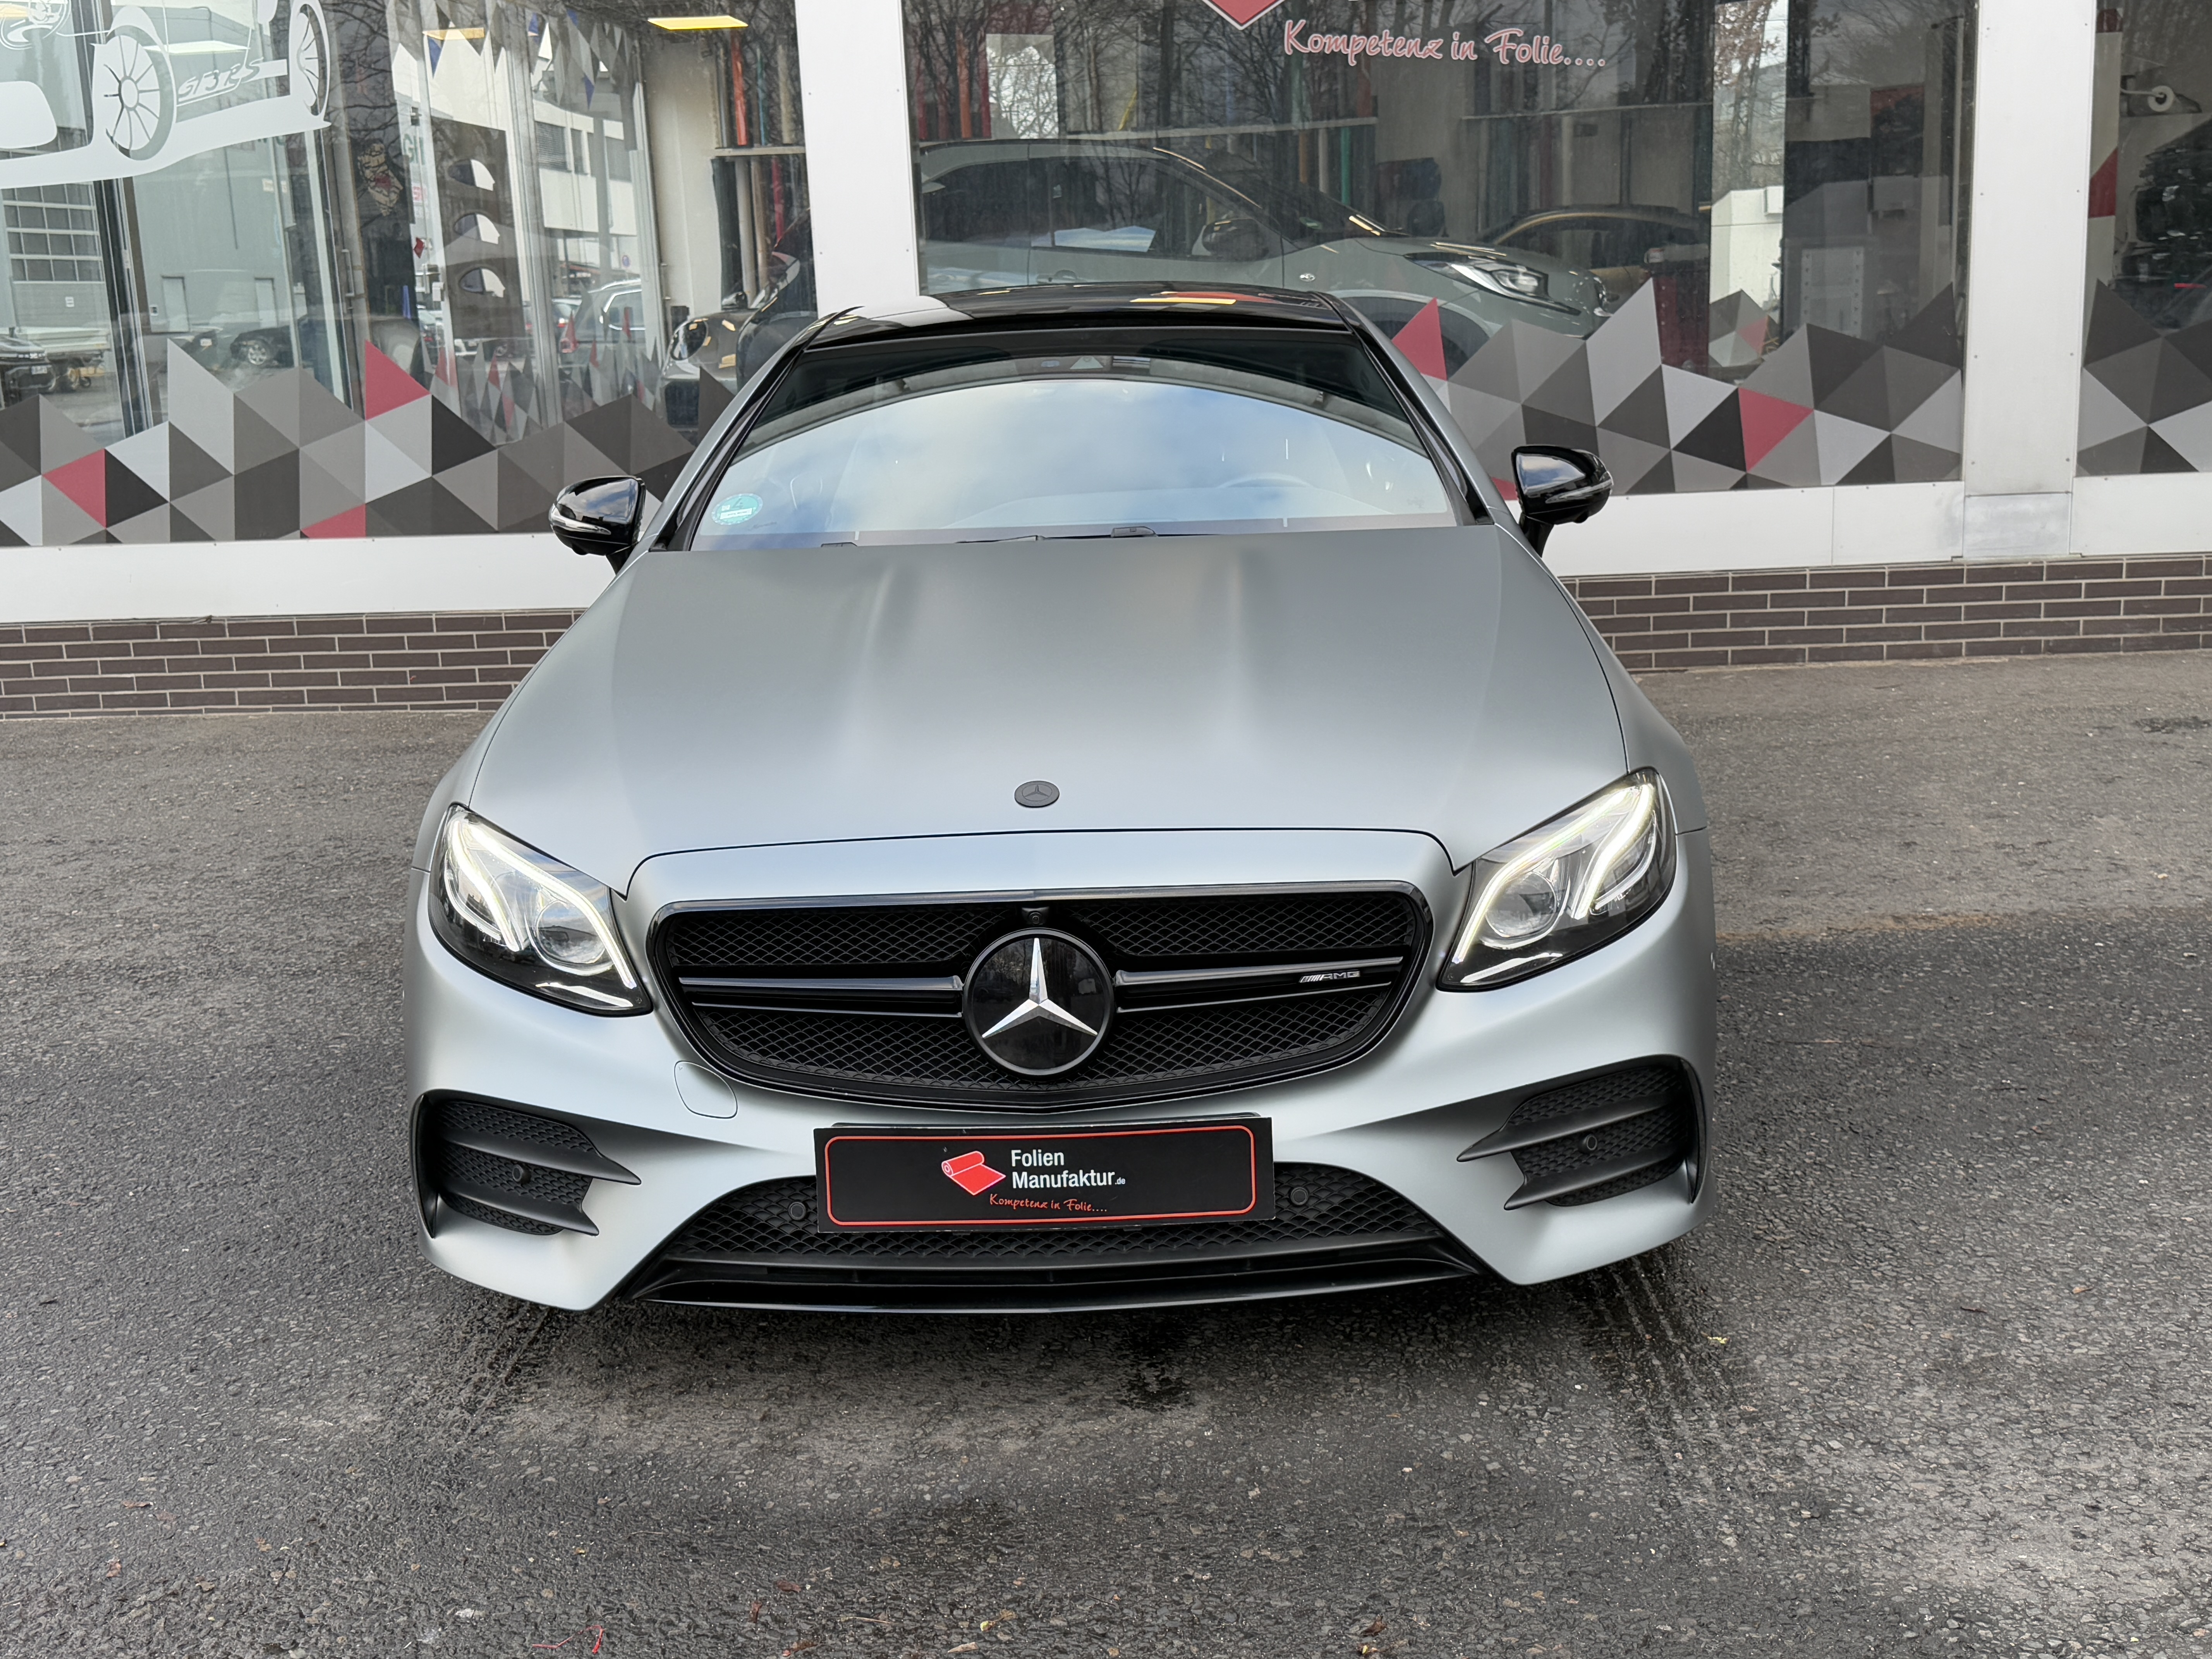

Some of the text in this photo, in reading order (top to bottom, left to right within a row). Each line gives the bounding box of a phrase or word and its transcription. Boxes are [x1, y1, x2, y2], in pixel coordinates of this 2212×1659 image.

[1284, 20, 1443, 66] Kompetenz
[1451, 31, 1478, 60] in
[1321, 971, 1360, 981] AMG
[1011, 1149, 1065, 1167] Folien
[990, 1194, 1048, 1209] Kompetenz
[1051, 1200, 1060, 1209] in
